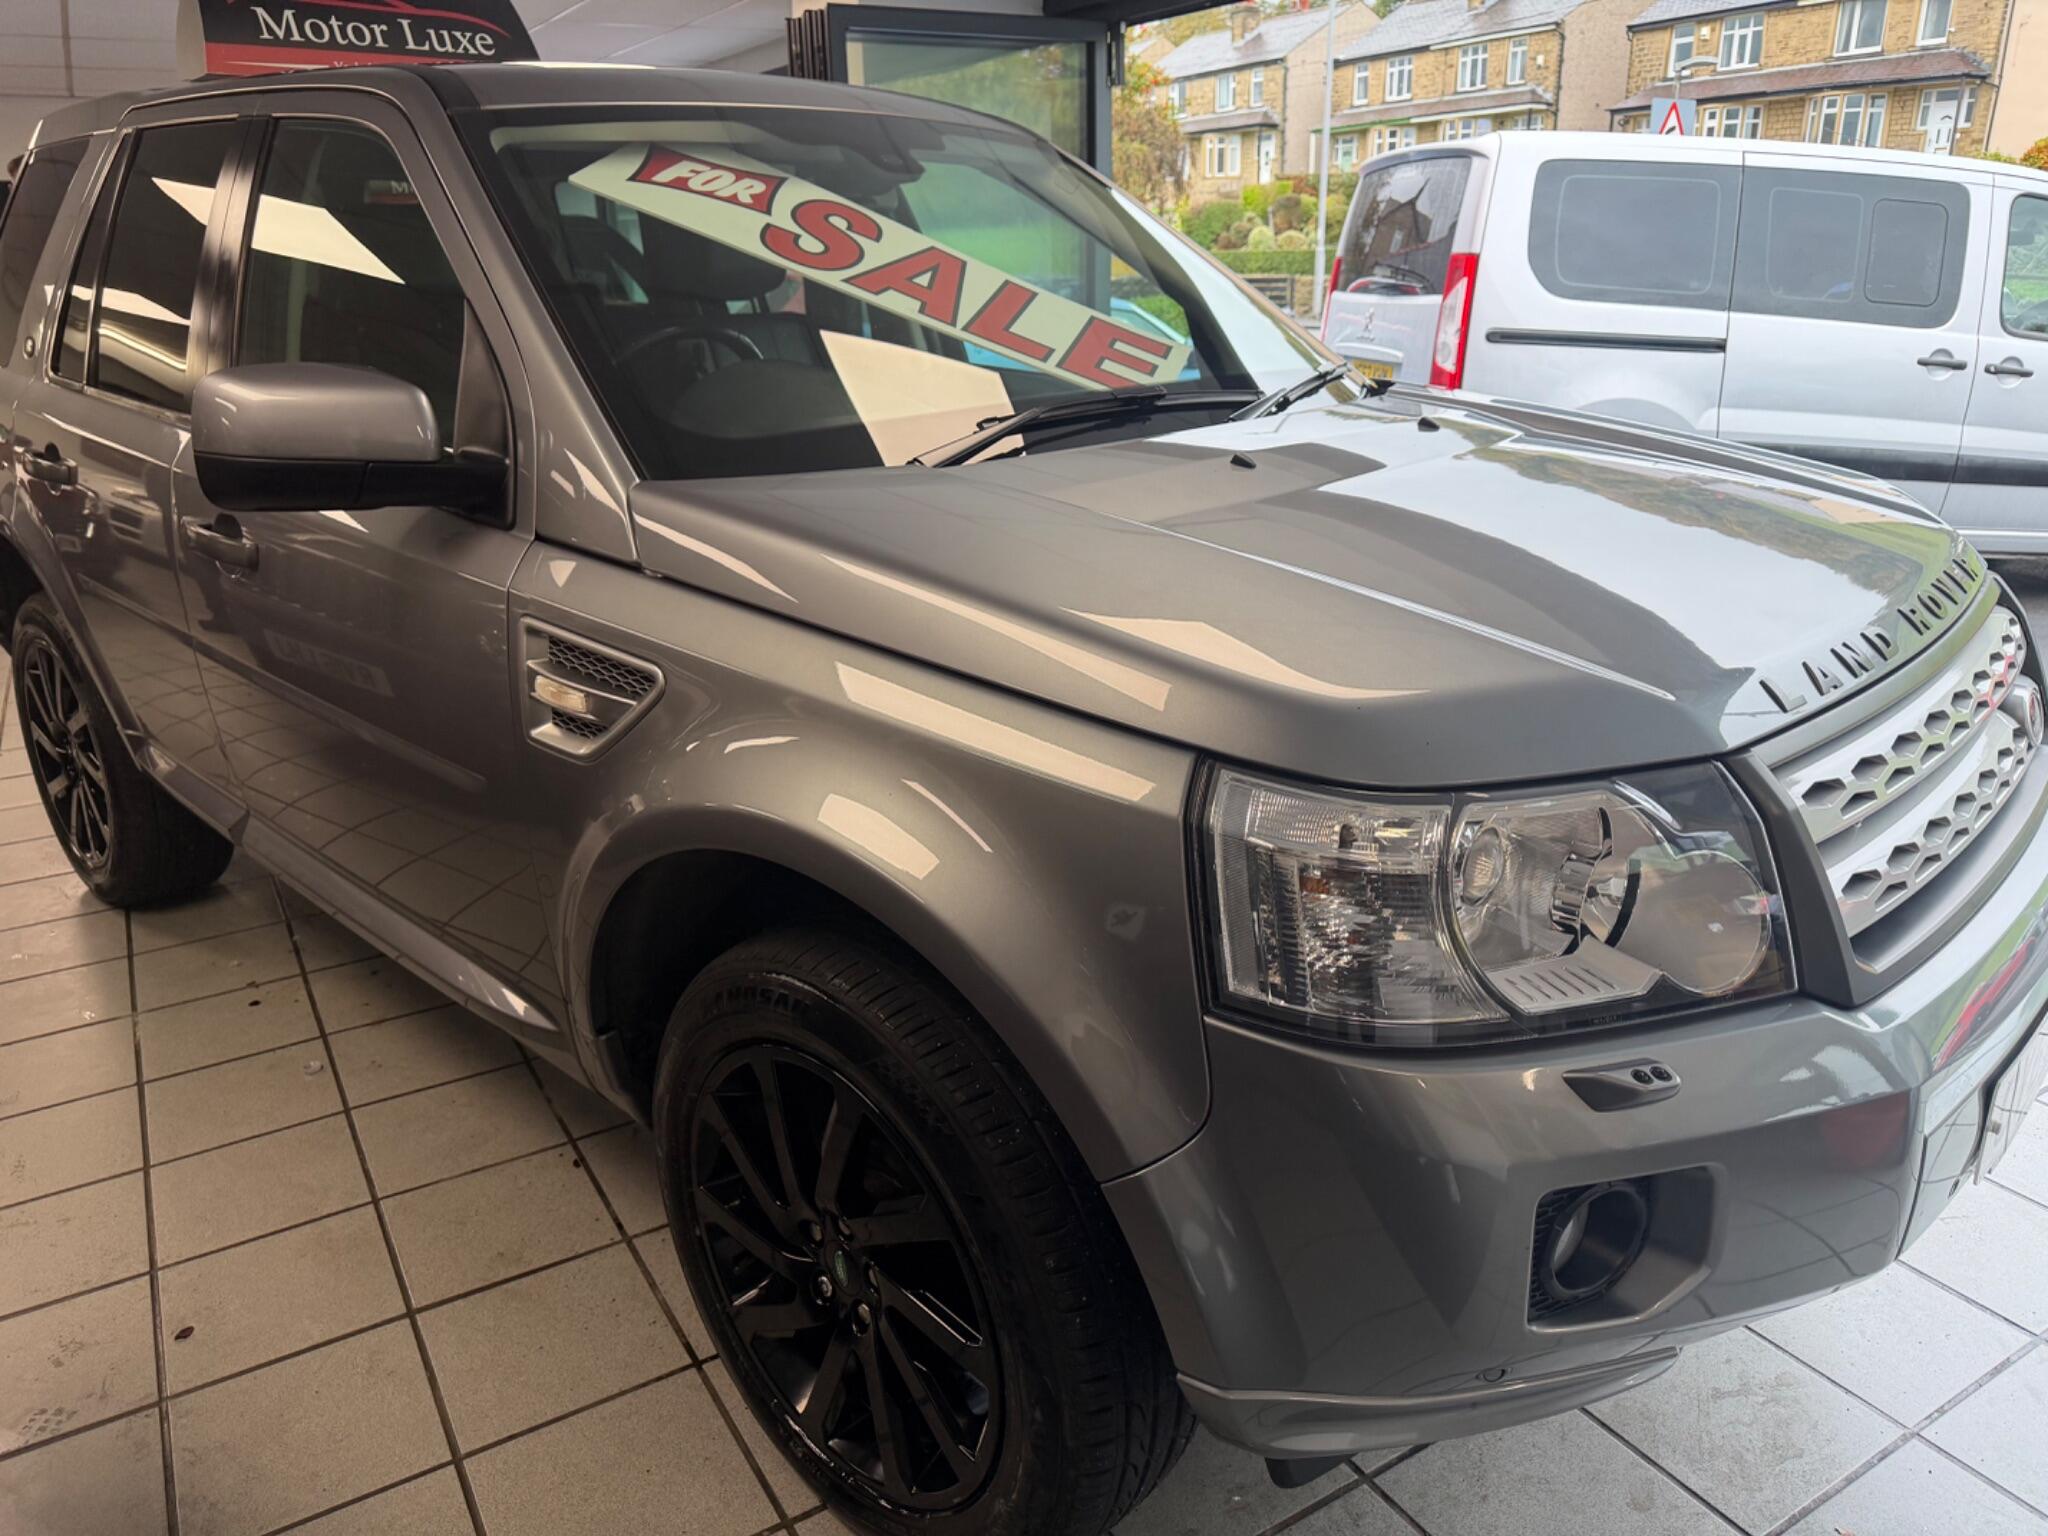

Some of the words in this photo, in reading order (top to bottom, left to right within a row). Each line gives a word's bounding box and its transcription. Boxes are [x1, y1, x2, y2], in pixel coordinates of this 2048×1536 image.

[250, 6, 389, 49] Motor
[396, 18, 496, 57] Luxe
[651, 158, 768, 206] FOR
[759, 198, 1175, 391] SALE
[1758, 626, 1899, 714] LAND
